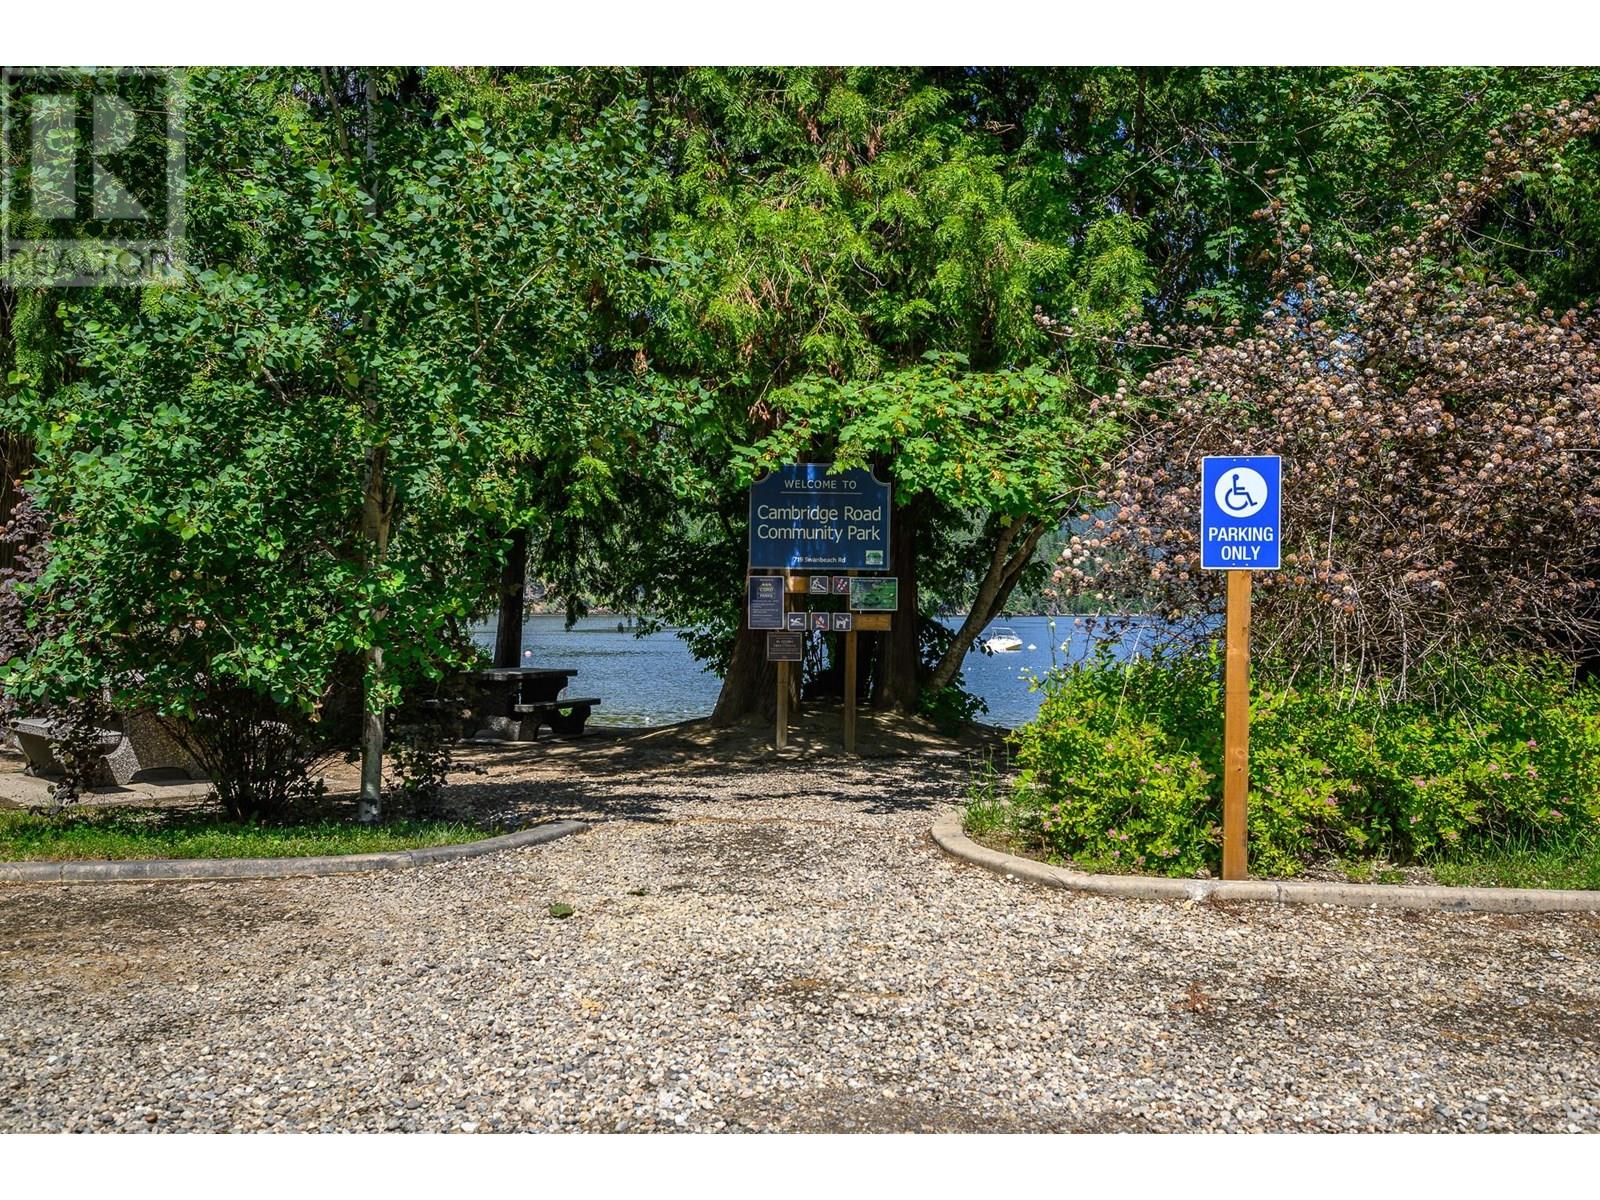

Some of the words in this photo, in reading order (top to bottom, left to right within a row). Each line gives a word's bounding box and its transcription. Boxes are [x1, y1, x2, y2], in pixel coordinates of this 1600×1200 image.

[784, 480, 837, 489] WELCOME
[842, 480, 857, 490] TO
[757, 504, 839, 524] Cambridge
[844, 505, 882, 521] Road
[757, 524, 843, 544] Community
[847, 525, 881, 541] Park
[1208, 527, 1274, 542] PARKING
[1221, 546, 1261, 560] ONLY
